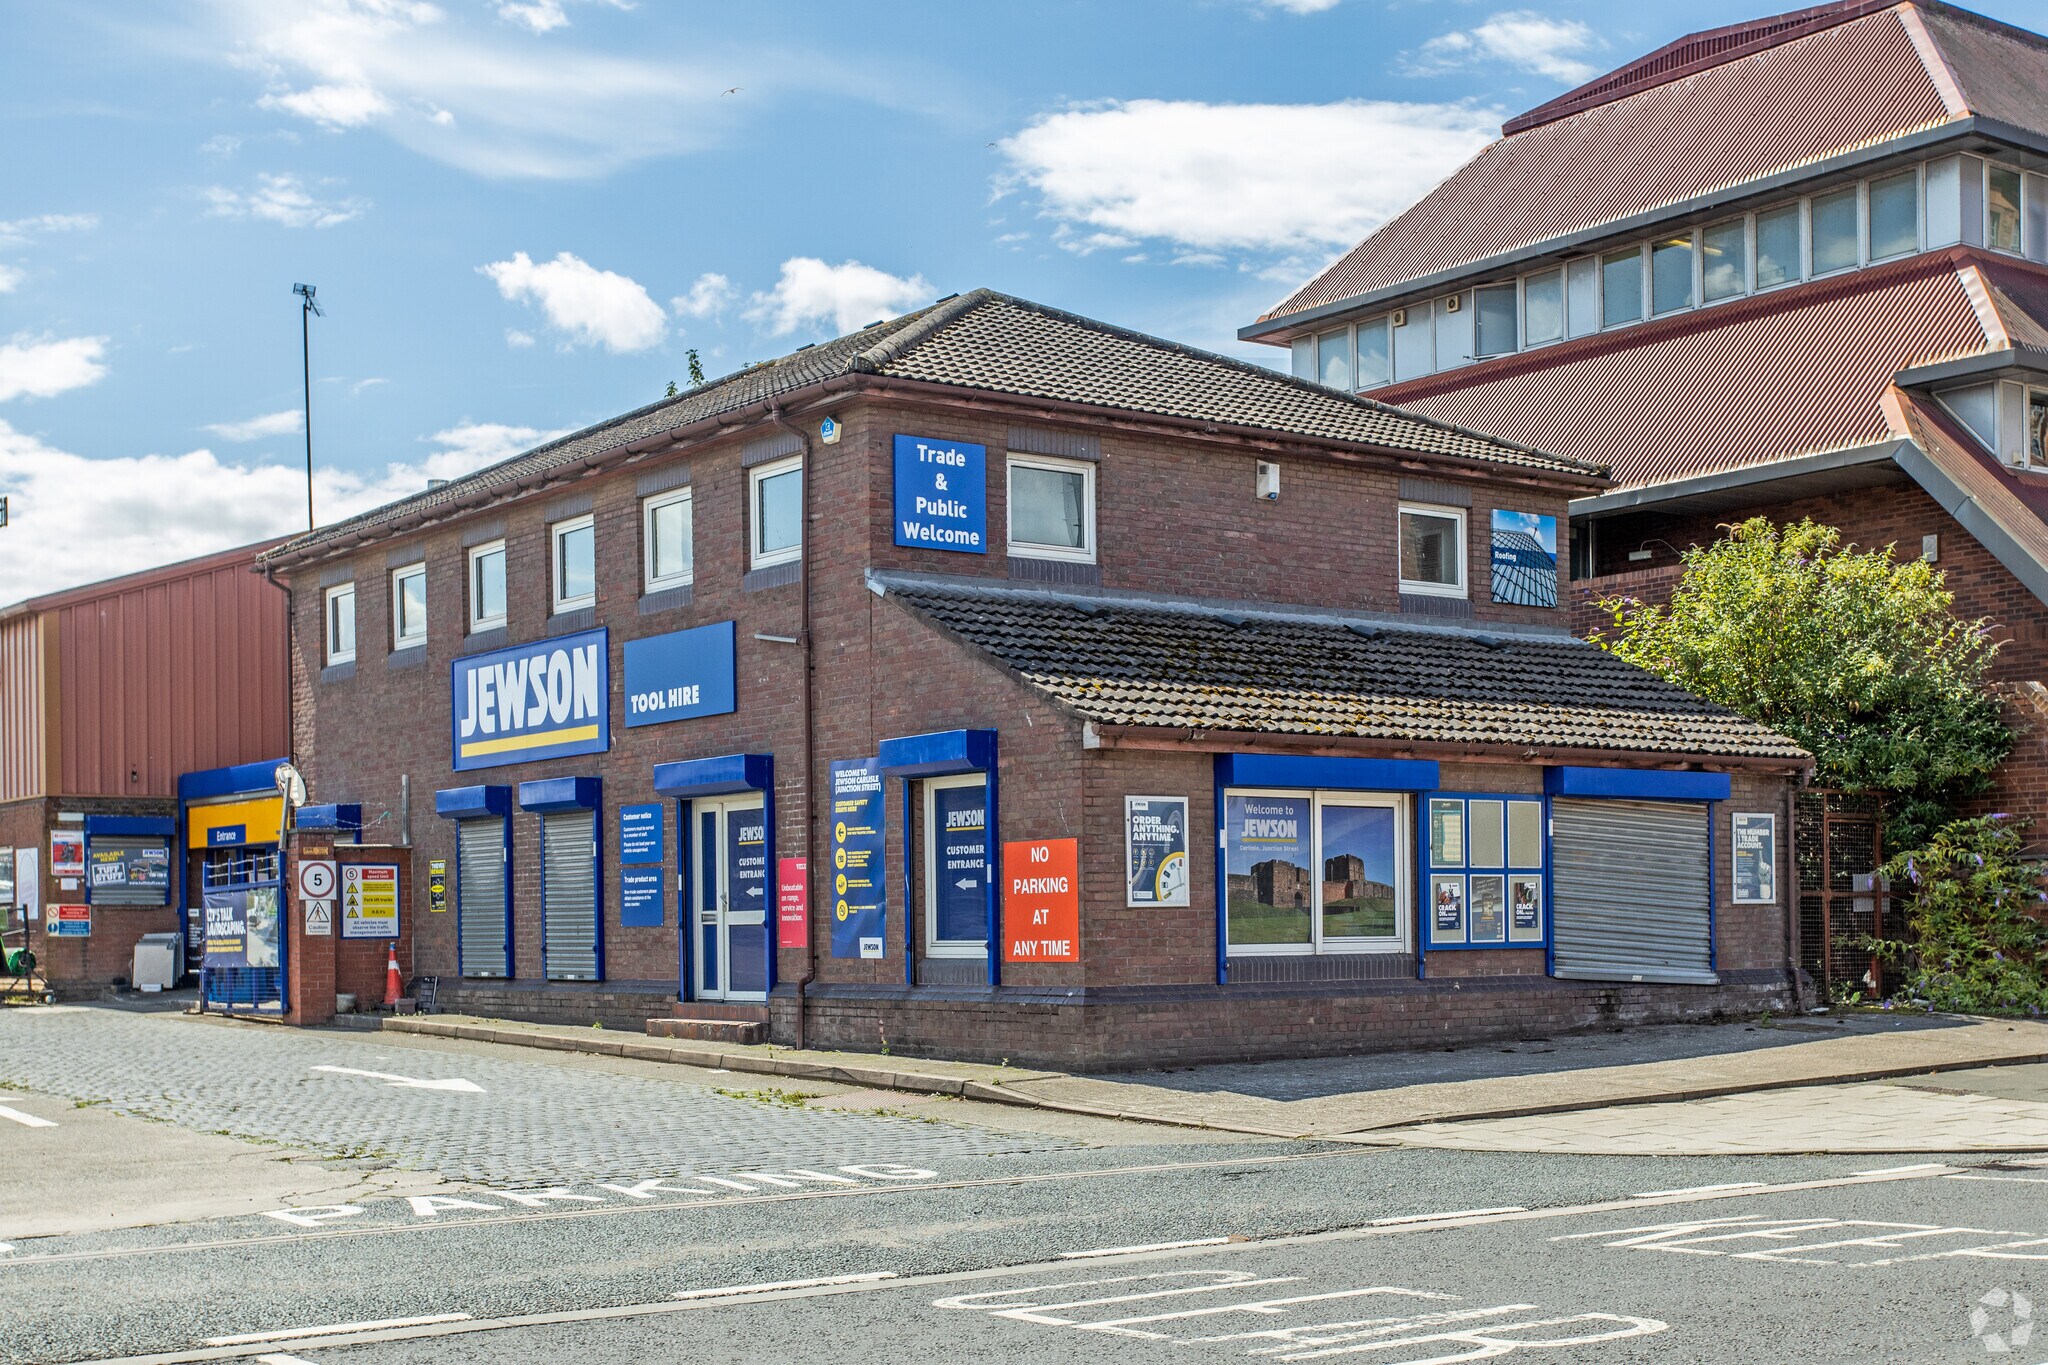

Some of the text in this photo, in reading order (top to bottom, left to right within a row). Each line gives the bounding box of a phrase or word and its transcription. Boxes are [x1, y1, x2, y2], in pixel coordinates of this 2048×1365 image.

[916, 444, 966, 466] Trade
[936, 473, 948, 490] &
[916, 496, 968, 518] Public
[903, 522, 980, 545] Welcome
[1494, 551, 1516, 562] Roofing
[461, 644, 598, 738] JEWSON
[631, 684, 700, 714] TOOL HIRE
[835, 769, 860, 778] WELCOME
[835, 775, 879, 785] JEWSON CARLISLE
[835, 782, 881, 795] (JUNCTION STREET)
[1244, 804, 1294, 815] Welcome to
[946, 809, 985, 827] JEWSON
[1133, 816, 1161, 824] ORDER
[216, 831, 236, 841] Entrance
[1133, 825, 1180, 834] ANYTHING.
[1242, 819, 1297, 838] JEWSON
[1133, 833, 1174, 842] ANYTIME.
[93, 850, 125, 859] AVAILABLE
[947, 845, 984, 855] CUSTOMER
[1031, 847, 1049, 862] NO
[97, 865, 120, 874] TUFF
[947, 859, 984, 870] ENTRANCE
[96, 872, 124, 882] STUFF
[314, 873, 322, 886] 5
[1013, 876, 1068, 894] PARKING
[206, 908, 221, 922] LET'S
[221, 907, 234, 921] TALK
[1033, 909, 1049, 925] AT
[207, 920, 246, 936] LANDSCAPING.
[1013, 940, 1070, 956] ANY TIME
[260, 1163, 938, 1228] PARKING
[932, 1269, 1668, 1365] CLEAR
